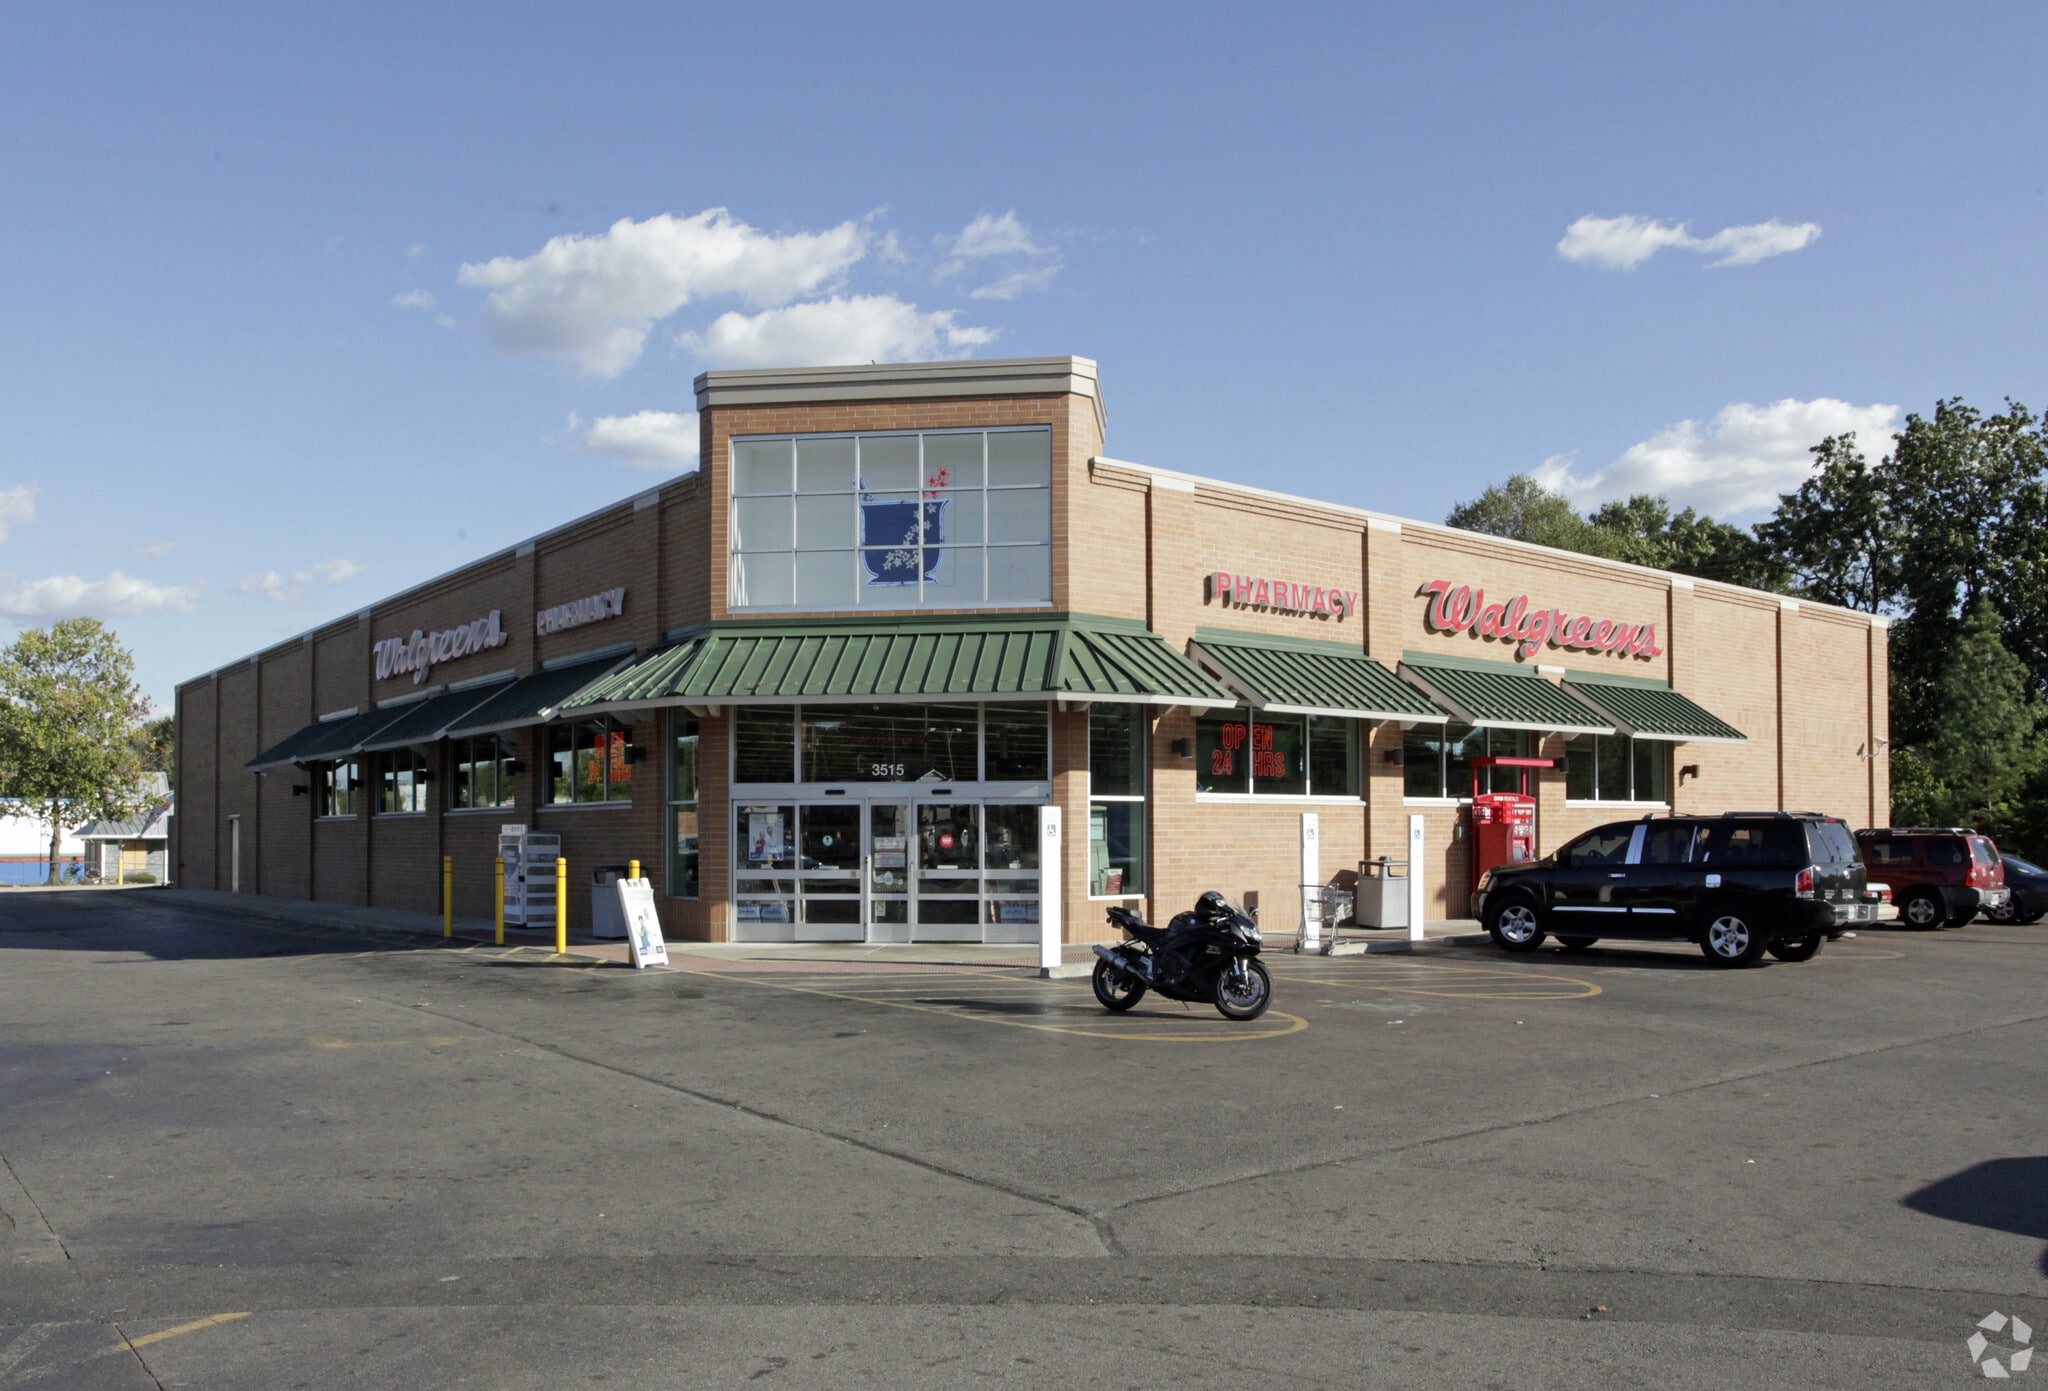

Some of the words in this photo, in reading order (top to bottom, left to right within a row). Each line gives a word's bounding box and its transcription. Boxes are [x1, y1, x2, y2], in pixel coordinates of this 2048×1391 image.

[1211, 572, 1358, 617] PHARMACY
[1422, 579, 1663, 658] Walgreens
[373, 610, 508, 684] Walgreens
[1222, 723, 1273, 750] OPEN
[871, 763, 905, 777] 3515
[1211, 750, 1233, 776] 24
[1252, 752, 1286, 778] HRS
